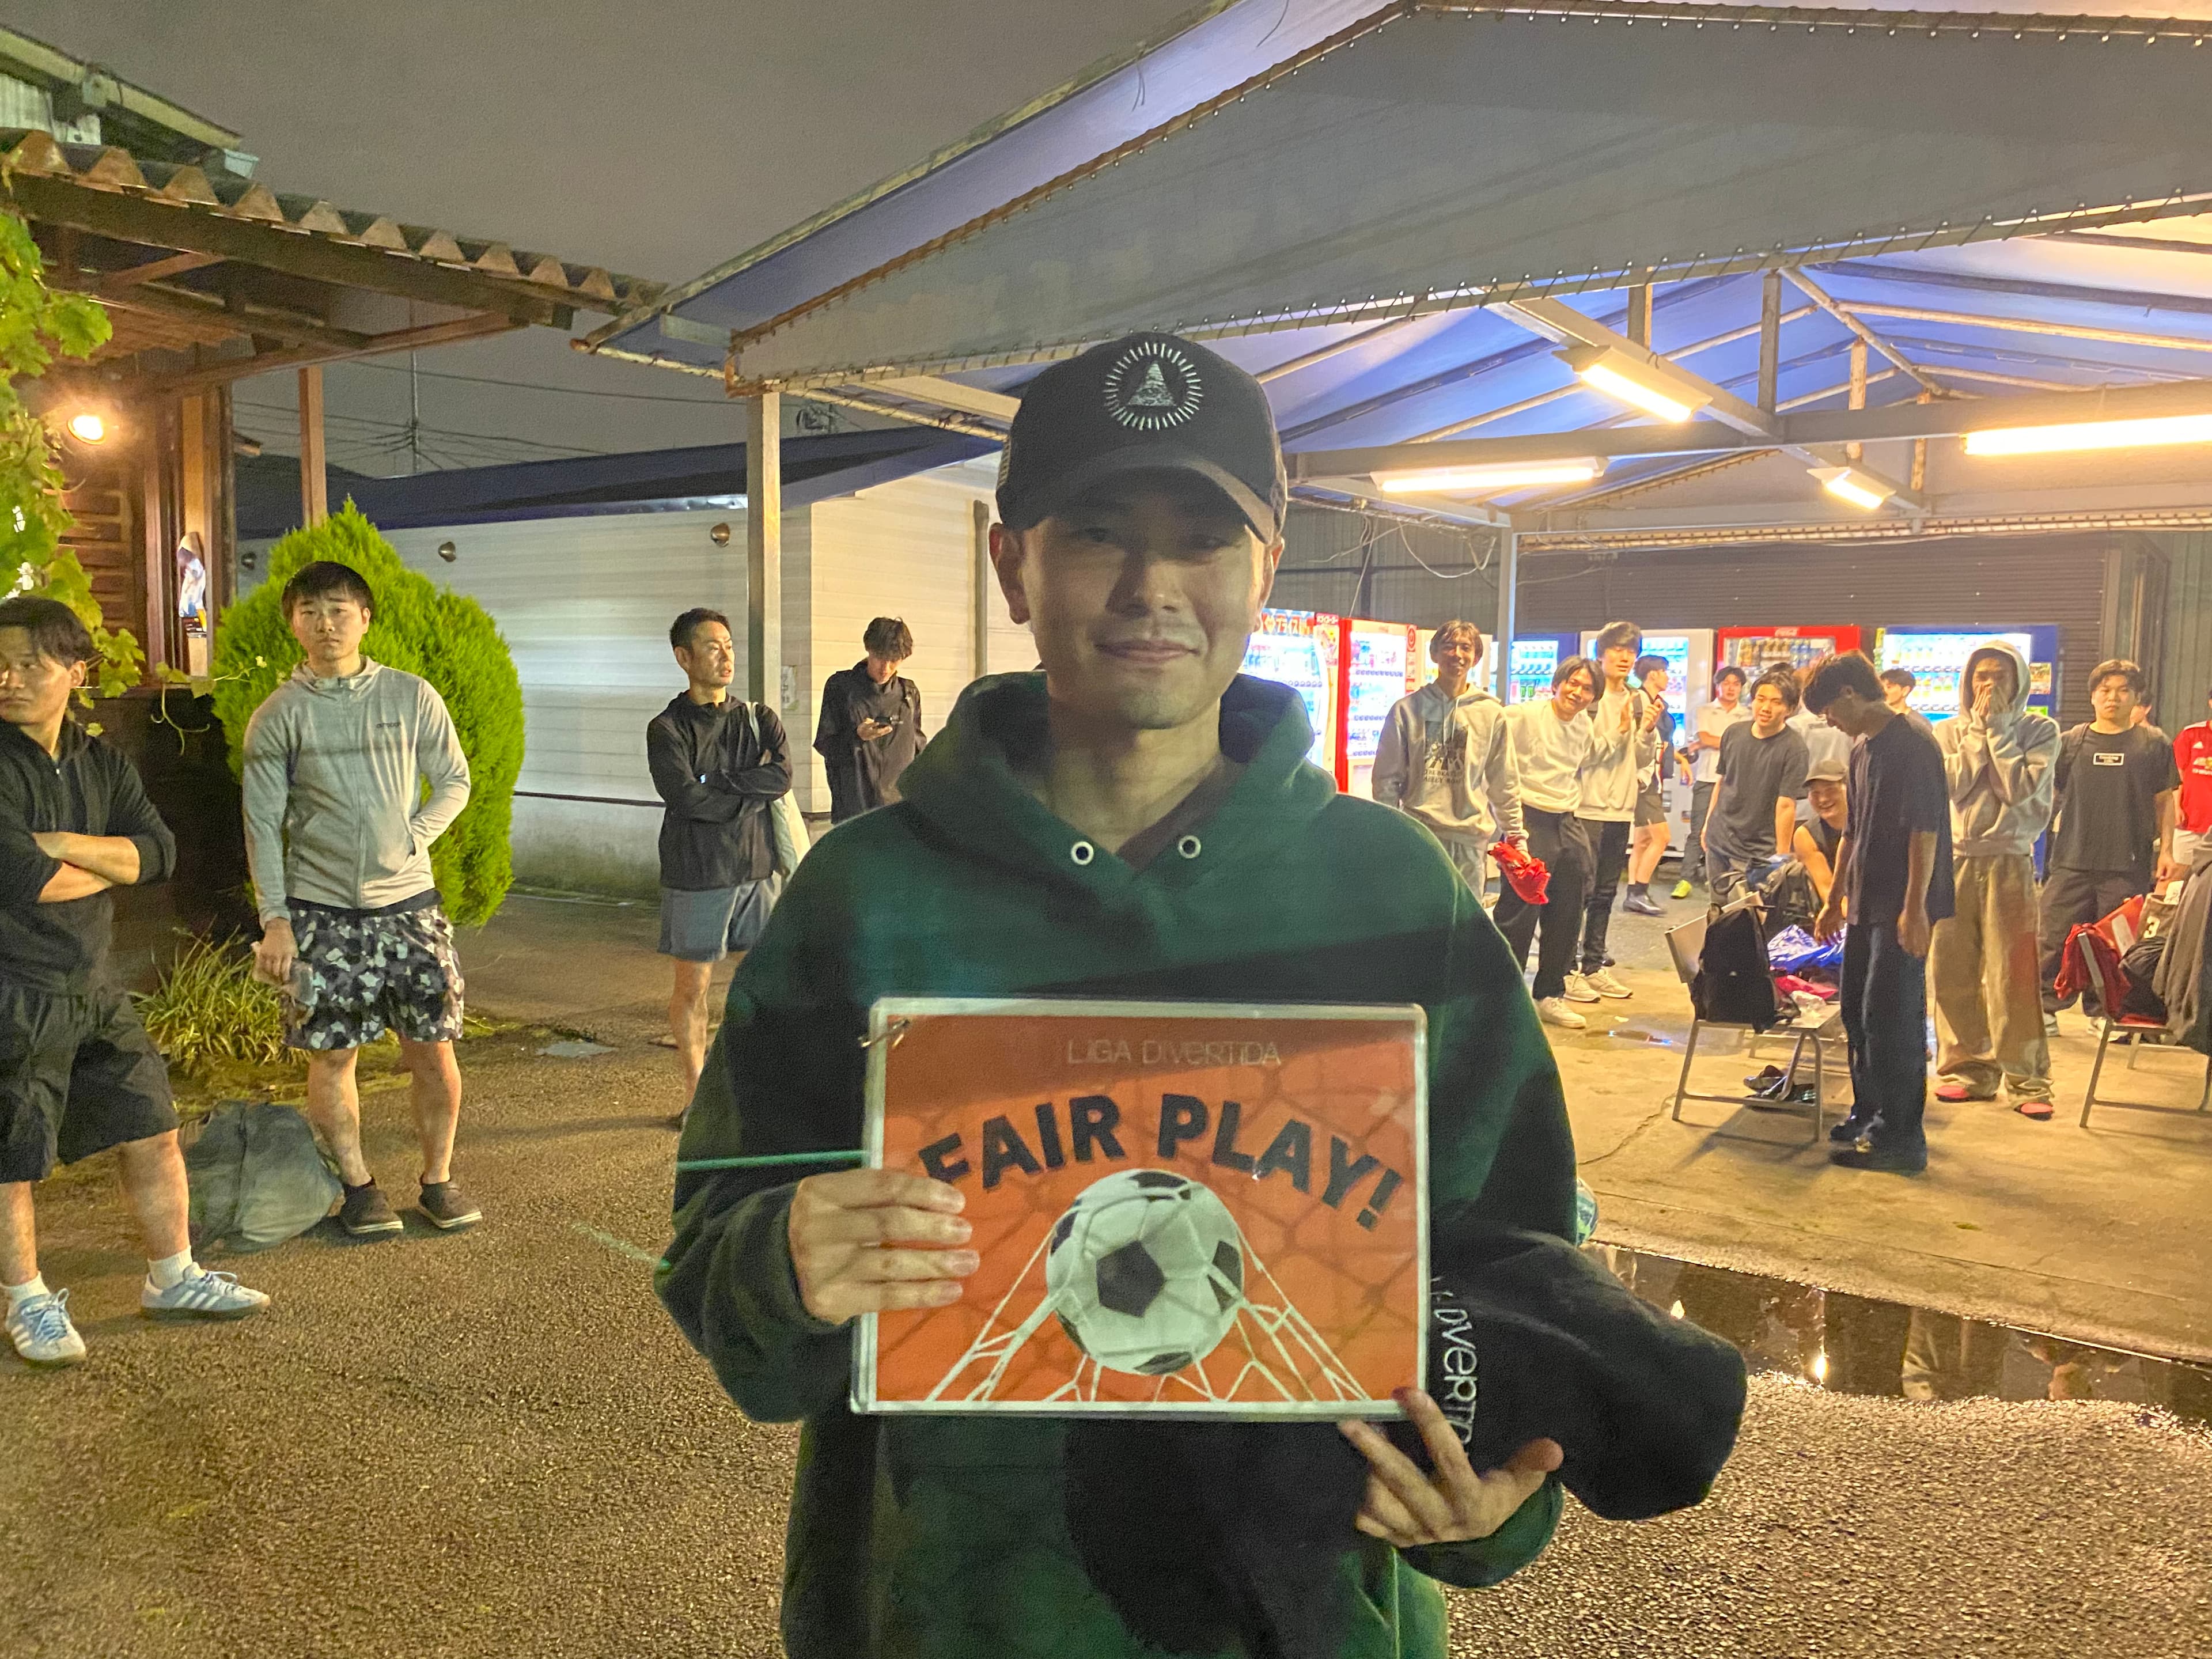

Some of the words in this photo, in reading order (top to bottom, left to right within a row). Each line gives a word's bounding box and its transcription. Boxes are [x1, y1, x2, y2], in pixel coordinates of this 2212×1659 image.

[2143, 915, 2160, 939] 3
[1067, 1039, 1132, 1065] LIGA
[918, 1094, 1126, 1190] FAIR
[1157, 1093, 1404, 1231] PLAY!
